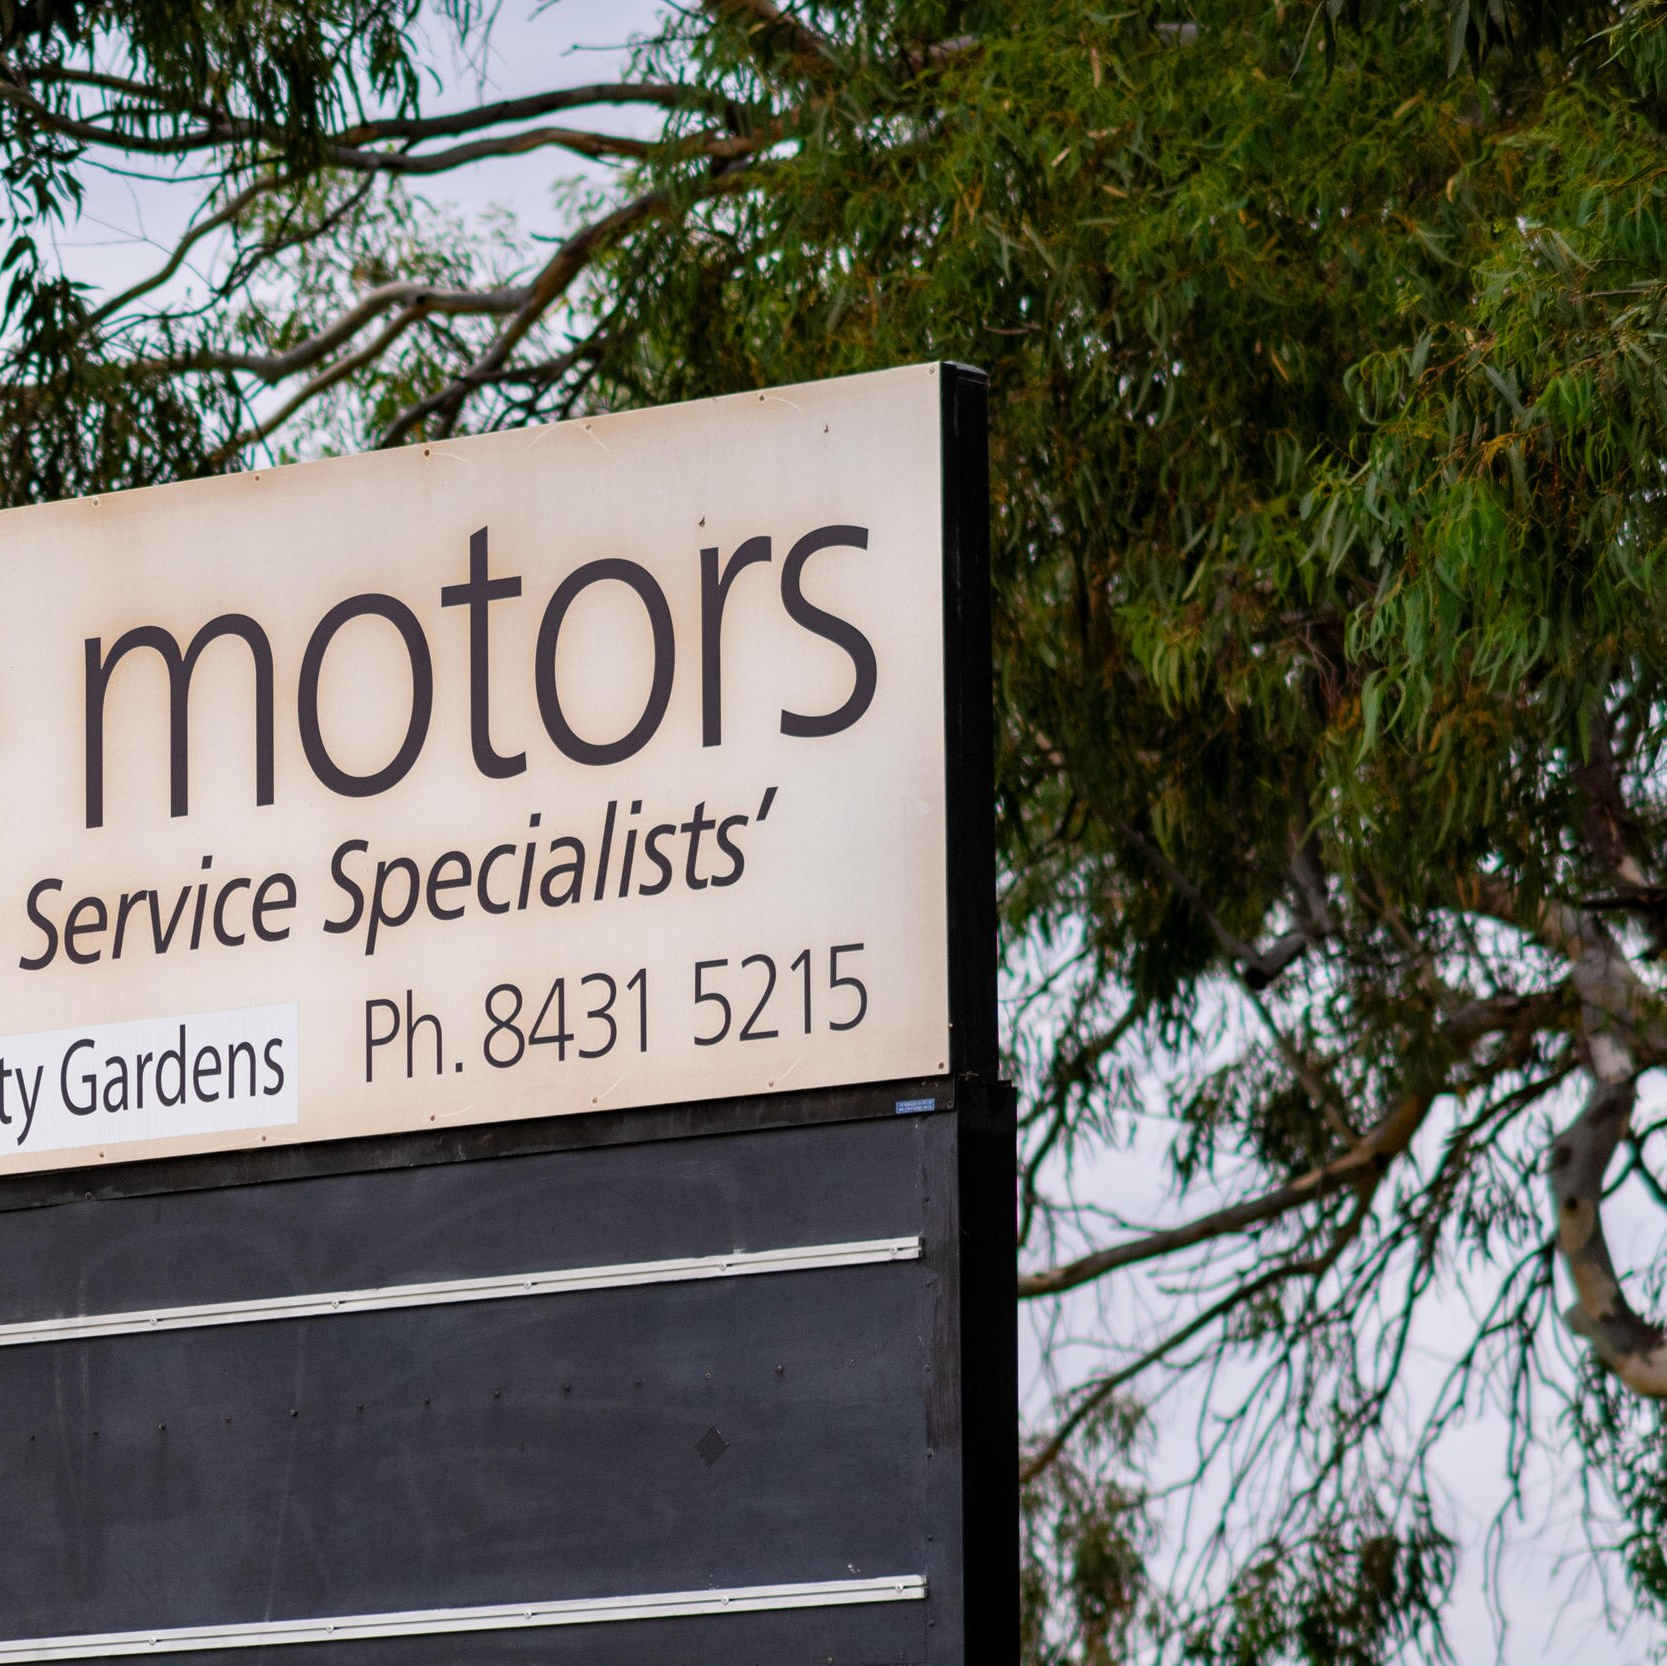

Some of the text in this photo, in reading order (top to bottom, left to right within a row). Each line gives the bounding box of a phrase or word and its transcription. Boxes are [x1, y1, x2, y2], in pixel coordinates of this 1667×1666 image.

[84, 524, 878, 829] motors
[19, 855, 297, 970] Service
[60, 1024, 285, 1116] Gardens
[365, 942, 869, 1083] Ph. 8431 5215
